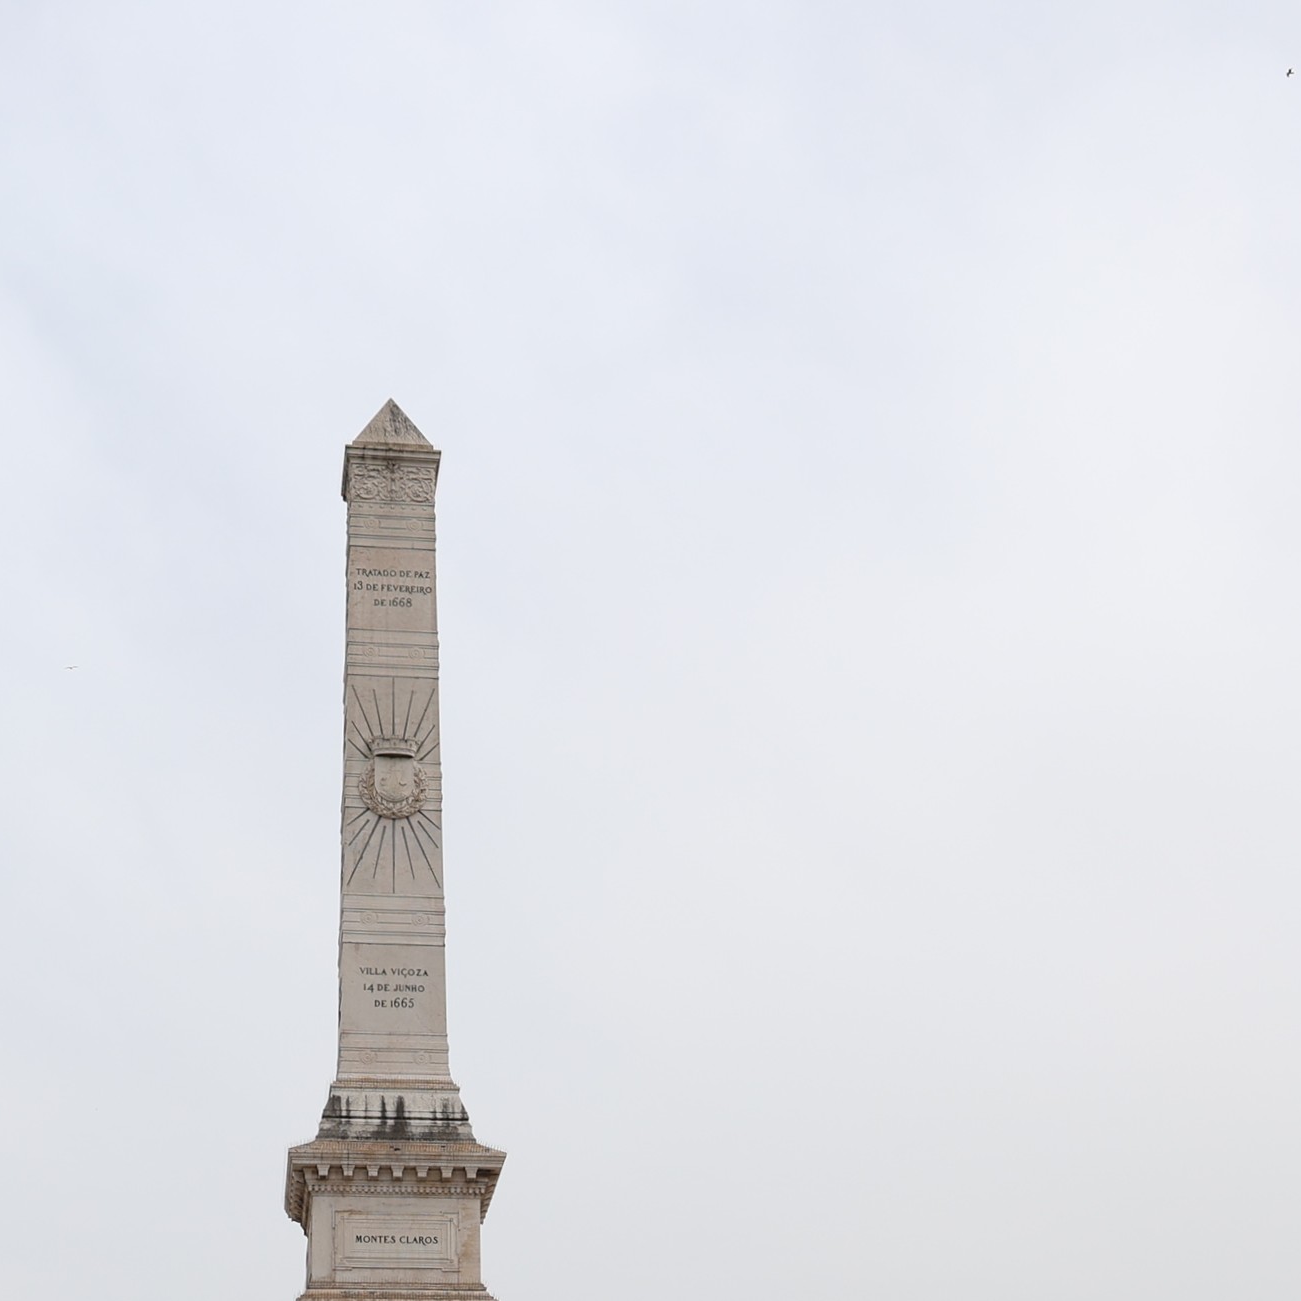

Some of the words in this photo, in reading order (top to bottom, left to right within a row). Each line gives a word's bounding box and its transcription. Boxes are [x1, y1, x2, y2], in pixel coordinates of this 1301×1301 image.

[355, 568, 397, 577] TRATADO
[399, 570, 412, 578] DE
[414, 571, 431, 579] PAZ
[353, 580, 364, 591] 13
[366, 583, 379, 592] DE
[381, 584, 433, 595] FEVEREIRO
[374, 599, 387, 607] DE
[389, 597, 413, 608] 1668
[359, 967, 387, 976] VILLA
[391, 968, 429, 979] VIÇOZA
[363, 983, 374, 993] 14
[377, 984, 390, 992] DE
[393, 984, 425, 993] JUNHO
[374, 1000, 387, 1008] DE
[390, 997, 415, 1008] 1665
[355, 1235, 396, 1244] MONTES
[399, 1236, 439, 1246] CLAROS
